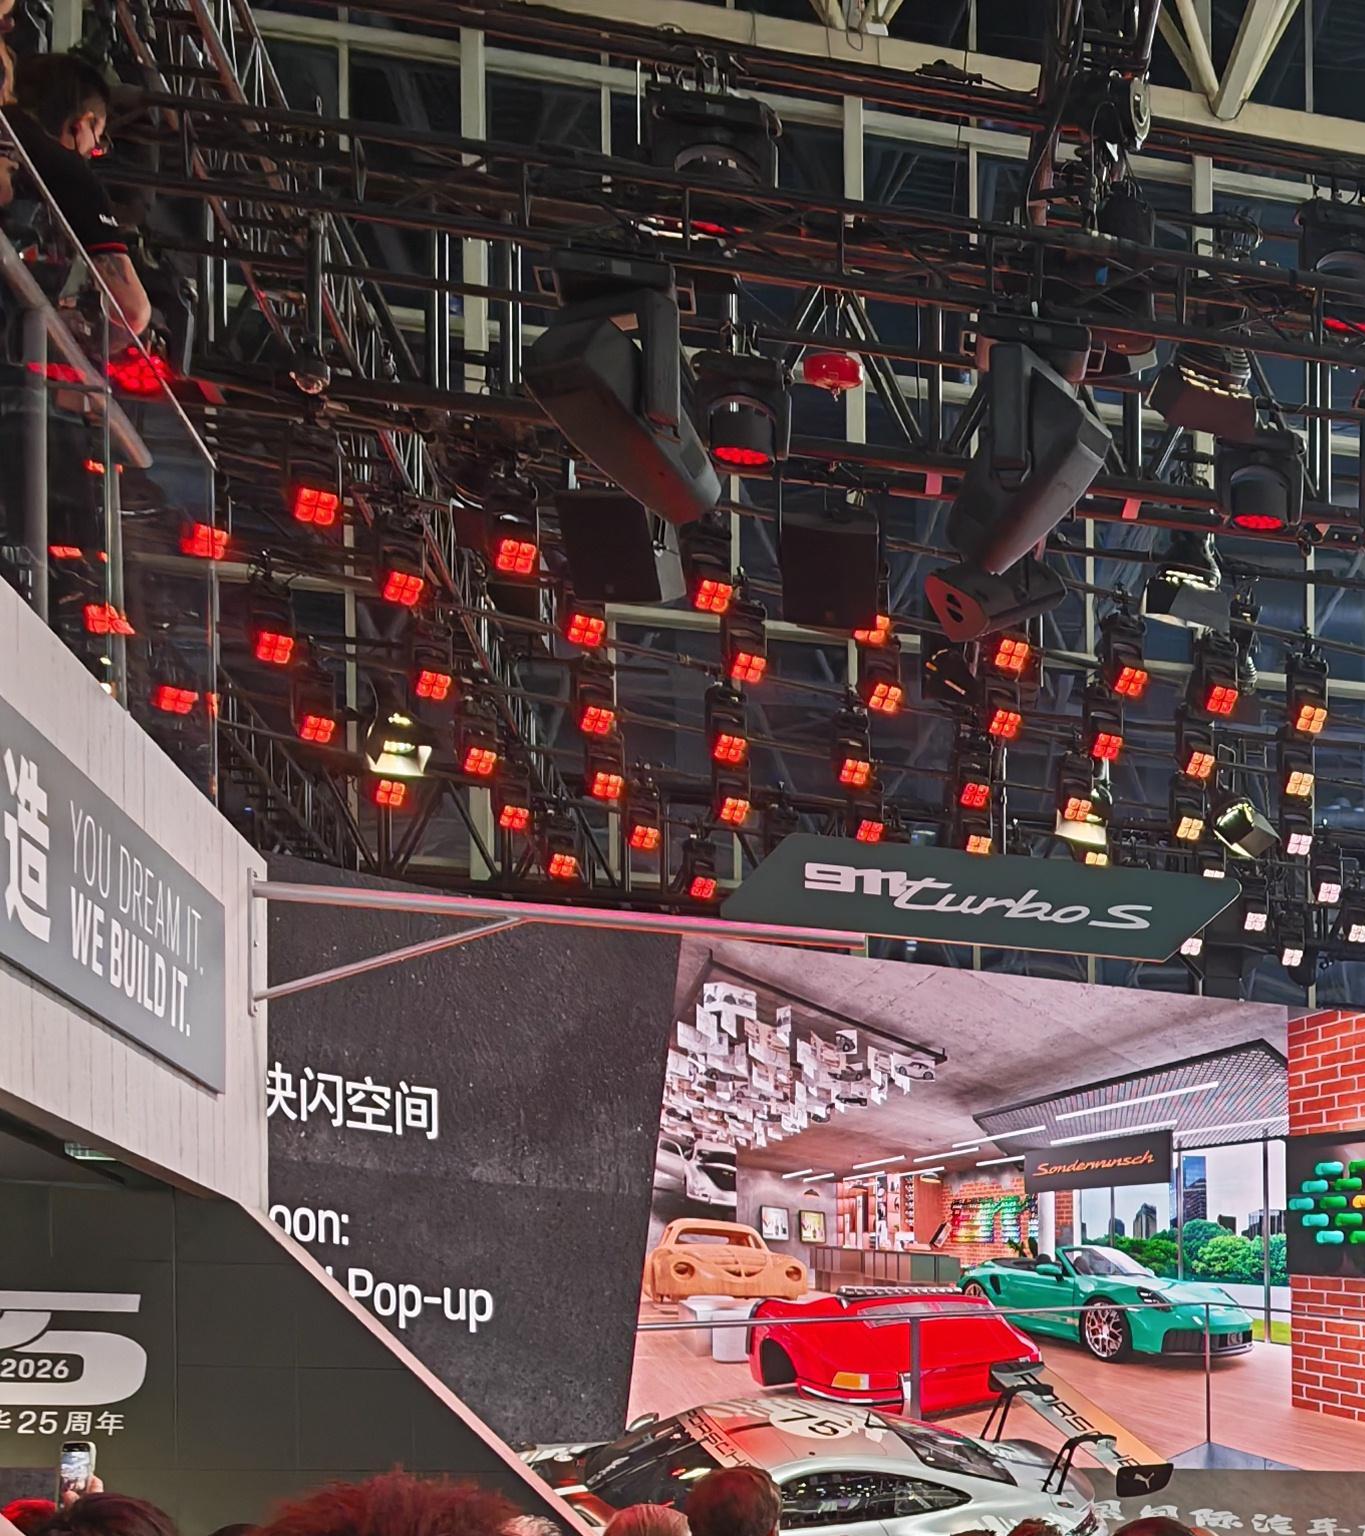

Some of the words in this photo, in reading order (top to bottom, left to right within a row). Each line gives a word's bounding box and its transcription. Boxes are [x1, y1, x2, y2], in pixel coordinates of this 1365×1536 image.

[4, 748, 50, 943] 造
[70, 801, 111, 898] YOU
[119, 845, 180, 956] DREAM
[187, 905, 203, 976] IT.
[805, 862, 908, 896] 911
[70, 886, 105, 977] WE
[110, 918, 166, 1018] BUILD
[171, 966, 190, 1036] IT.
[348, 1268, 494, 1333] Pop-up
[780, 1409, 849, 1437] 75
